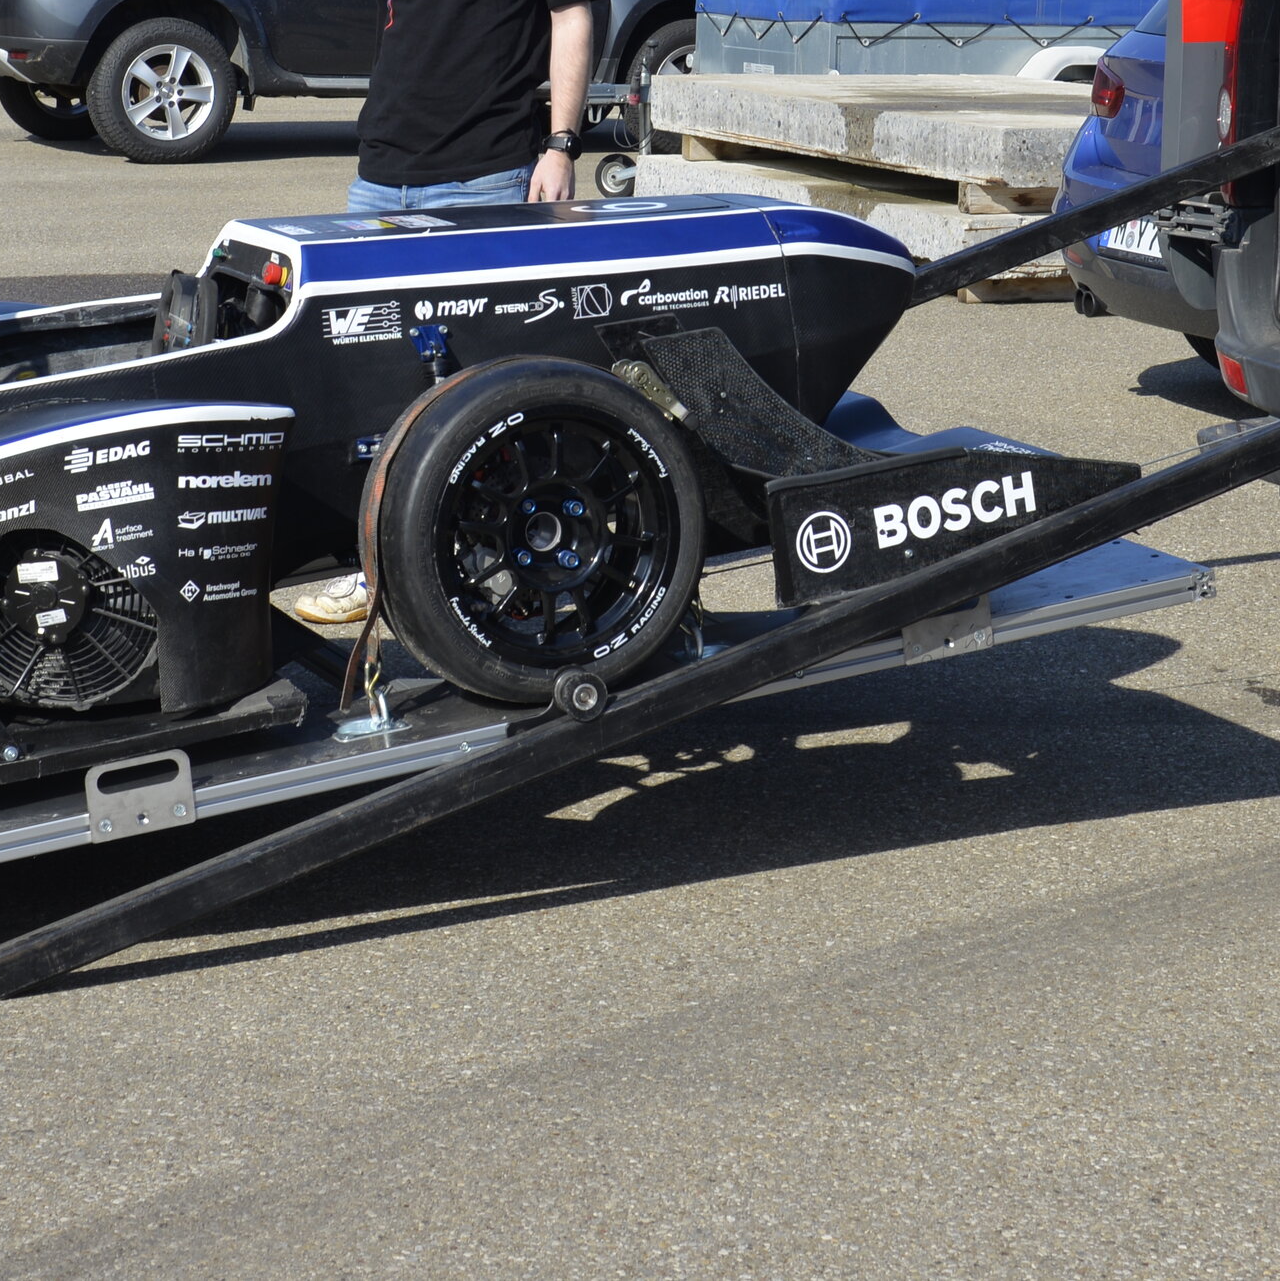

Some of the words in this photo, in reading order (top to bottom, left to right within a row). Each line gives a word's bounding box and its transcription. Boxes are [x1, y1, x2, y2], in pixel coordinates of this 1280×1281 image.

[638, 288, 709, 306] carbovation
[738, 283, 786, 302] RIEDEL
[436, 297, 489, 318] mayr
[668, 300, 710, 311] TECHNOLOGIES
[332, 335, 358, 346] WÜRTH
[359, 332, 403, 343] ELEKTRONIK
[176, 431, 285, 448] SCHMID
[95, 440, 151, 465] EDAG
[176, 444, 284, 454] MOTORSPORT
[448, 436, 487, 485] RACING
[177, 470, 273, 489] norelem
[206, 506, 268, 525] MULTIVAC
[873, 470, 1037, 550] BOSCH
[114, 524, 143, 535] surface
[115, 529, 154, 543] treatment
[202, 590, 240, 602] Automotive
[630, 586, 667, 634] RACING
